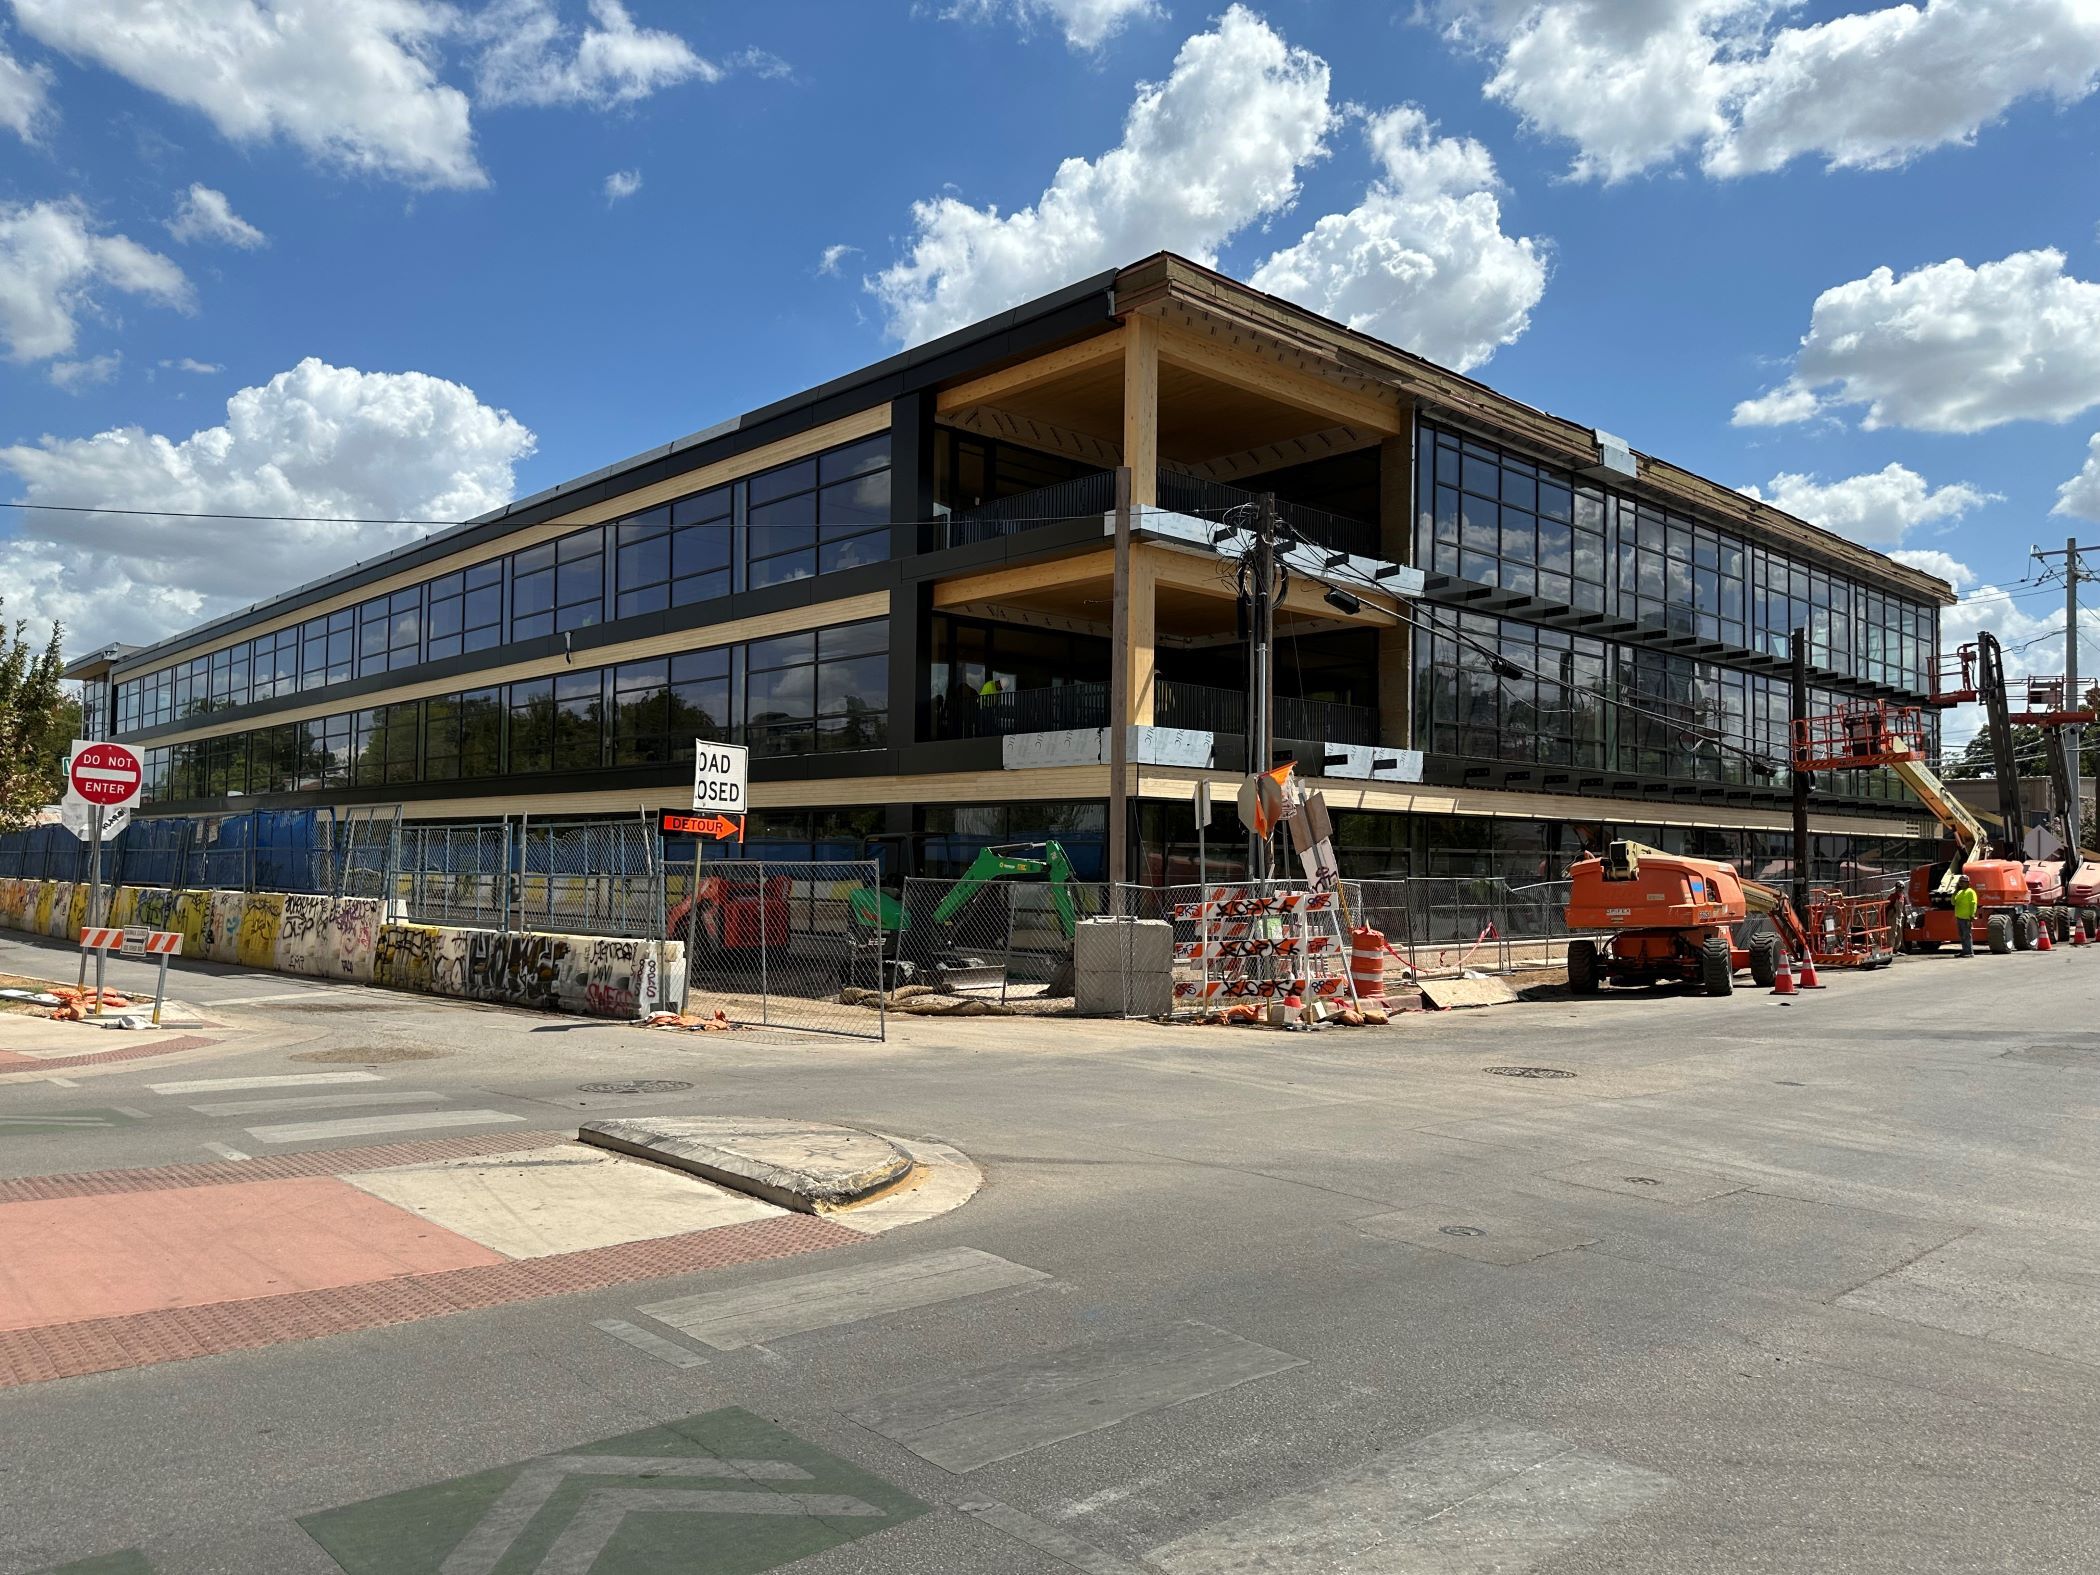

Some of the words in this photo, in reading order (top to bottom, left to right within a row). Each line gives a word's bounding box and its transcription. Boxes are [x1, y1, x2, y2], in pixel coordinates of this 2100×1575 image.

[83, 754, 101, 765] DO
[108, 756, 133, 768] NOT
[85, 781, 125, 795] ENTER
[697, 780, 740, 802] OSED
[672, 817, 724, 833] DETOUR
